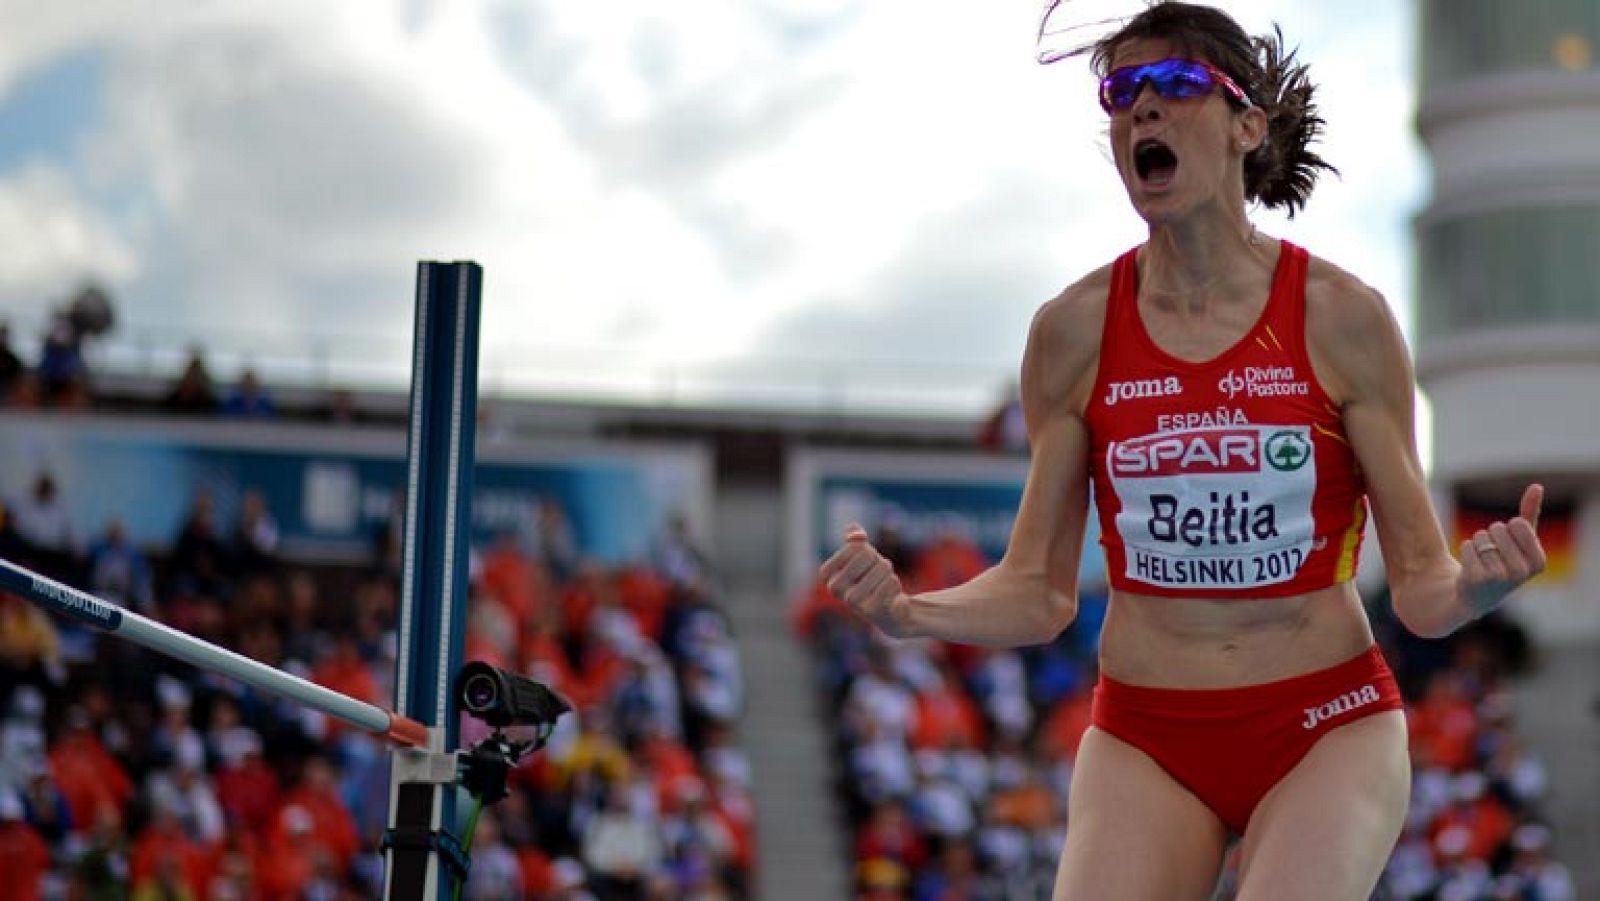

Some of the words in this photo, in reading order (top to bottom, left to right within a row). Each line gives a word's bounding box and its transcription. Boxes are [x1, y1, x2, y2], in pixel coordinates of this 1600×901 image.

[1244, 366, 1294, 381] Divina
[1247, 380, 1308, 397] Pastora
[1104, 375, 1183, 406] Joma
[1158, 406, 1248, 431] ESPAÑA
[1115, 434, 1256, 472] SPAR
[1147, 490, 1279, 547] Beitia
[1136, 552, 1244, 584] HELSINKI
